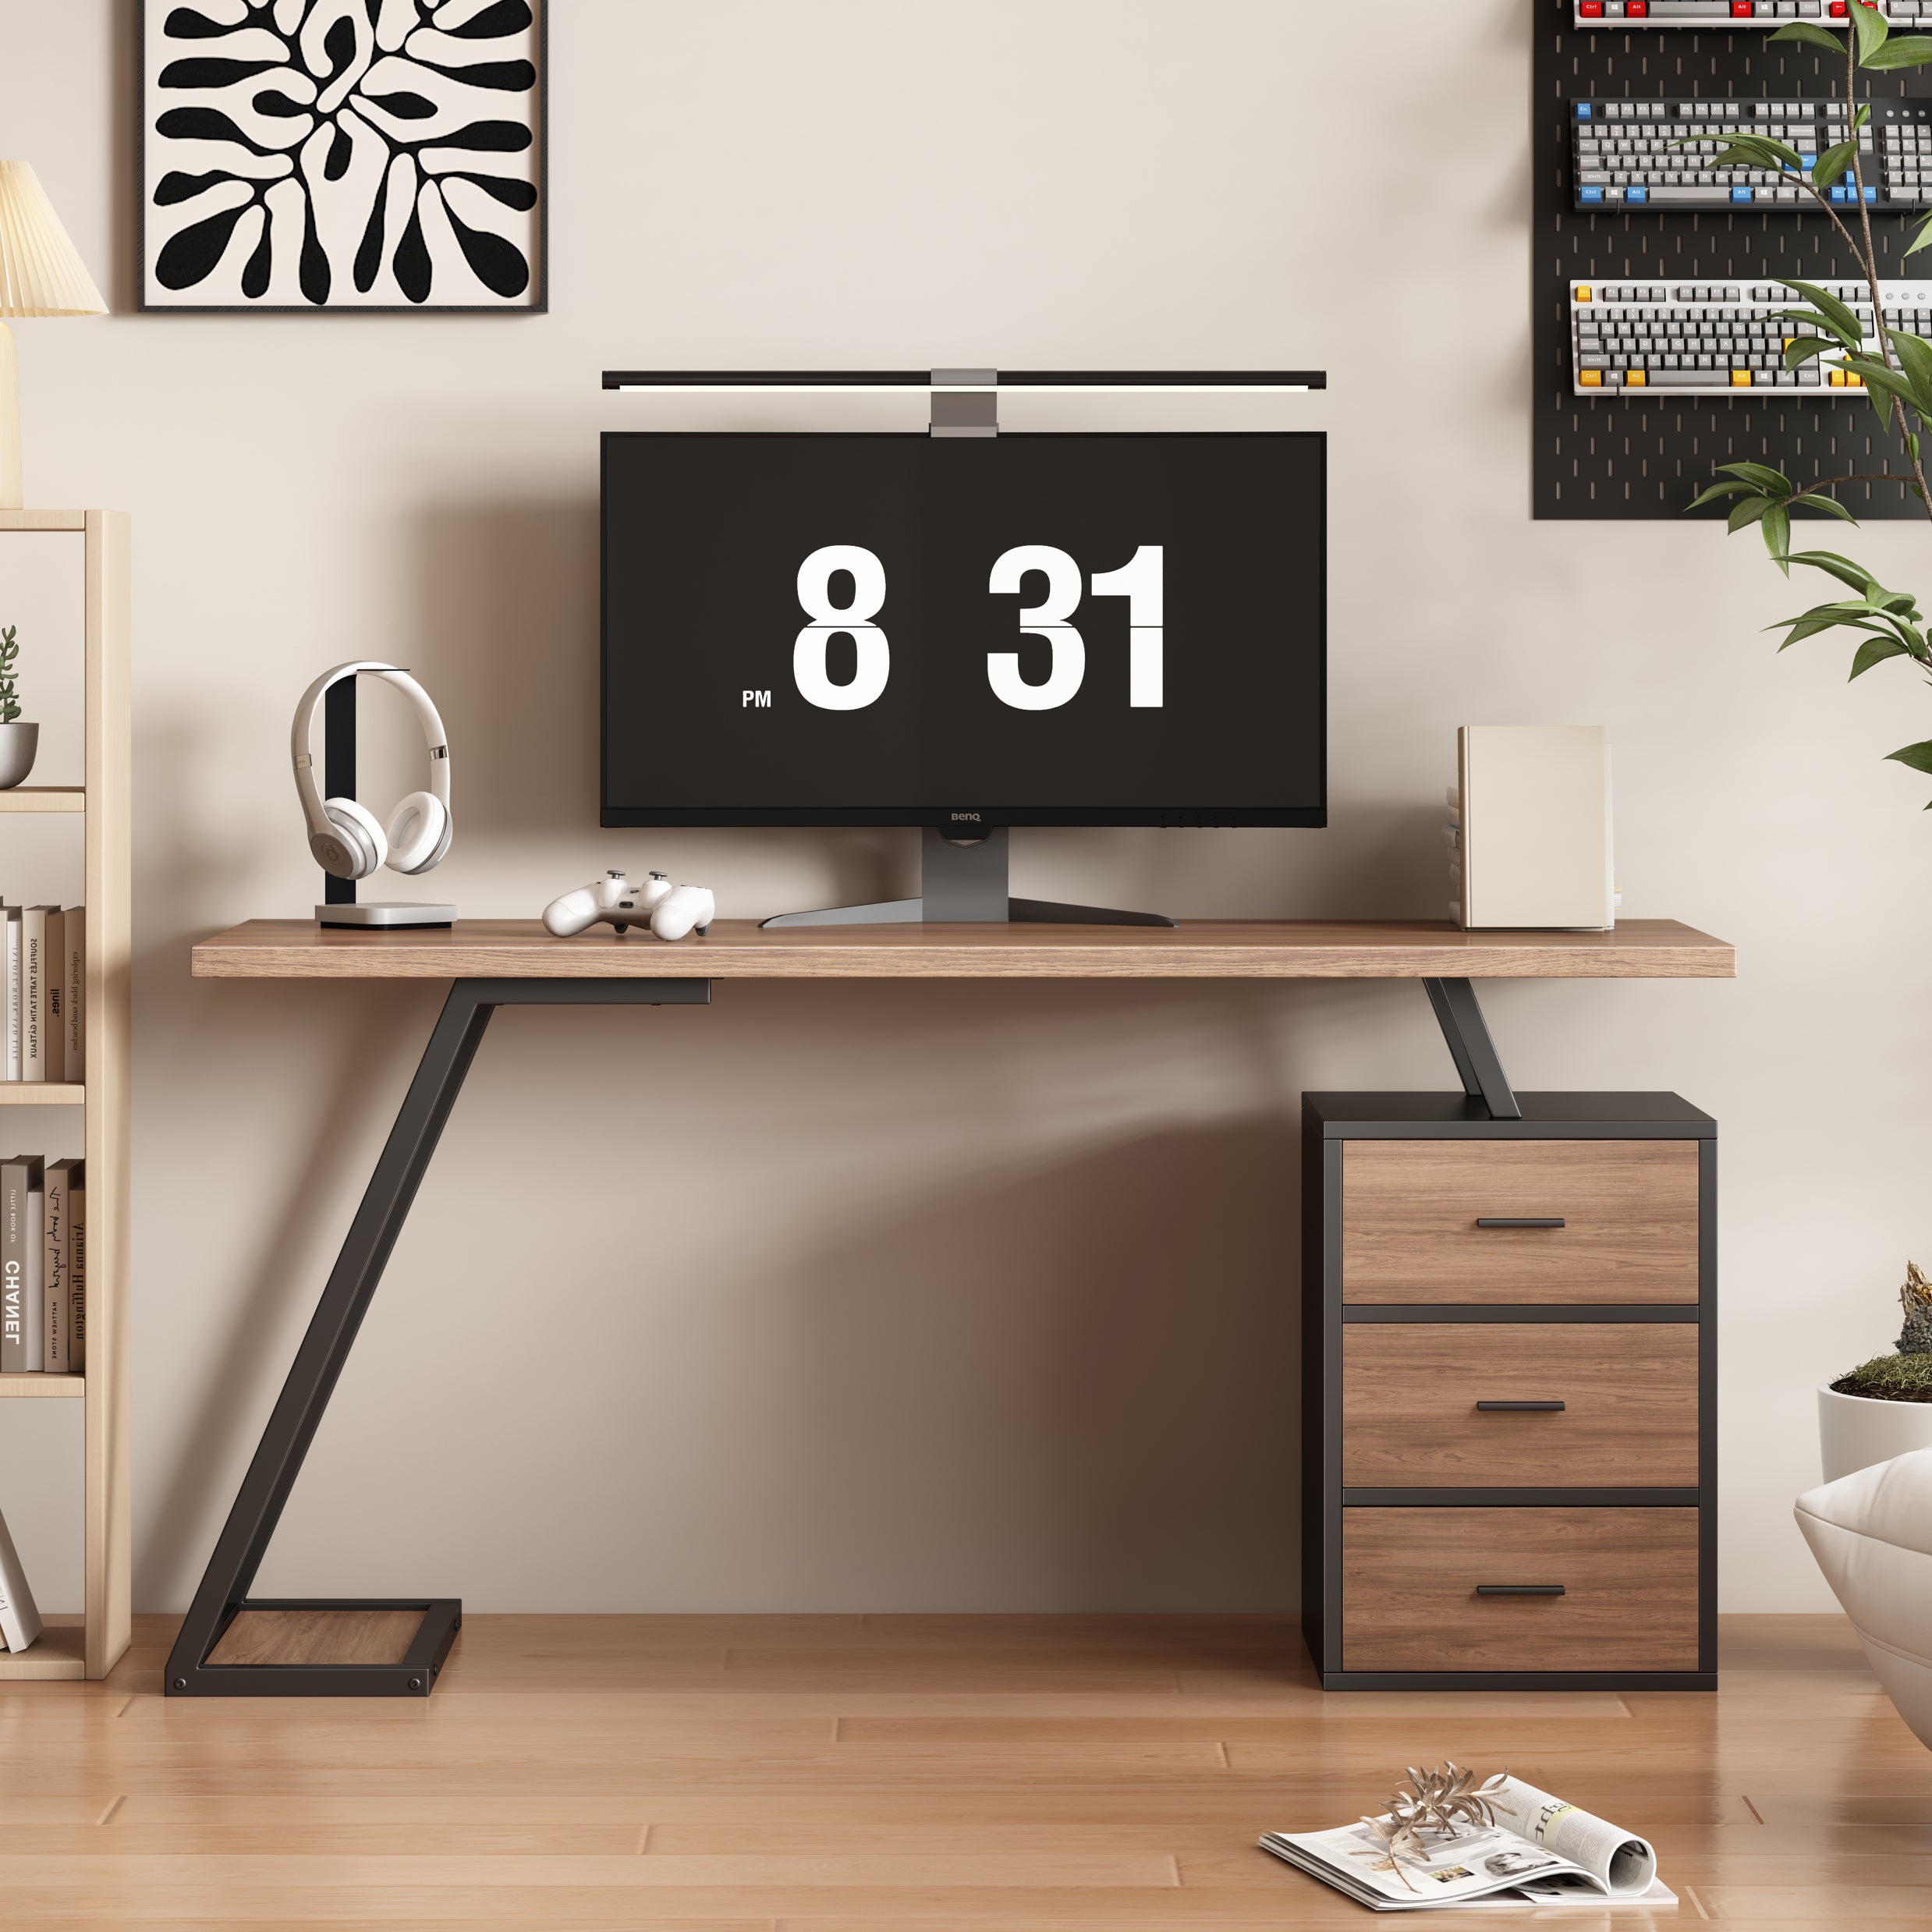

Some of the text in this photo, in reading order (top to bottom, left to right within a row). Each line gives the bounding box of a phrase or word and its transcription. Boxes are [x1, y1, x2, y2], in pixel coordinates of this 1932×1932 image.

[743, 544, 1164, 711] PM 8 31
[951, 813, 981, 822] BenQ
